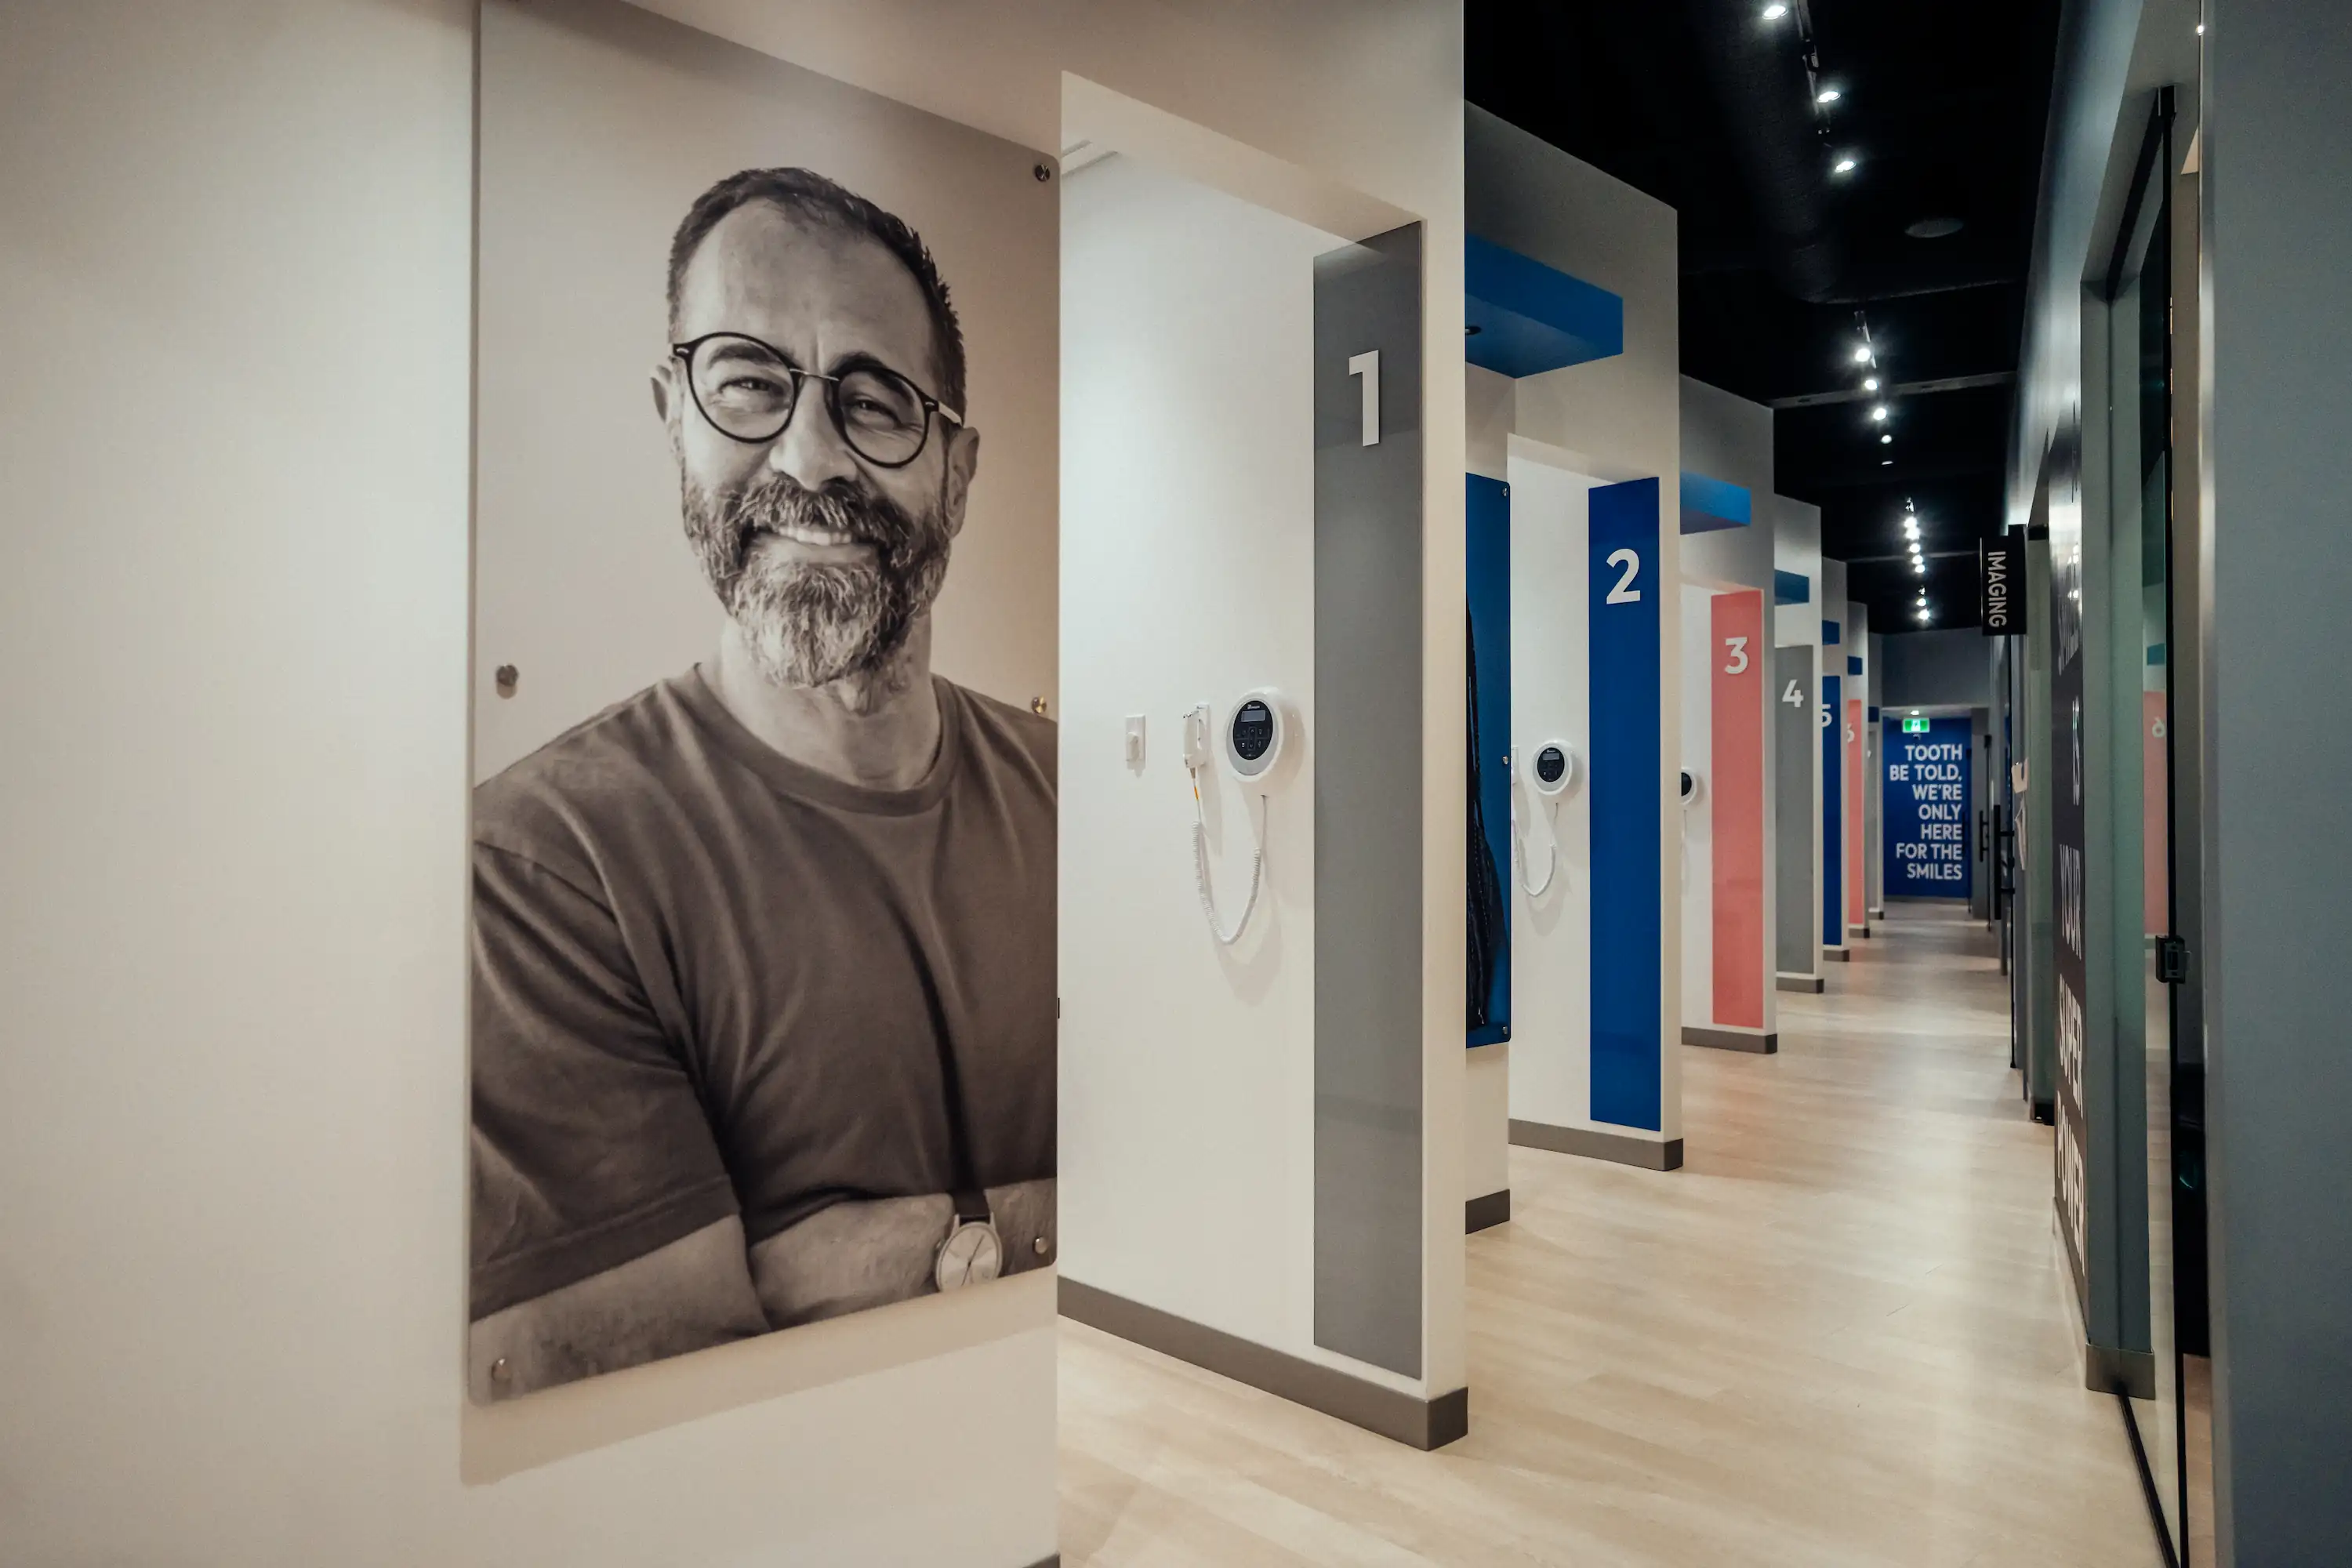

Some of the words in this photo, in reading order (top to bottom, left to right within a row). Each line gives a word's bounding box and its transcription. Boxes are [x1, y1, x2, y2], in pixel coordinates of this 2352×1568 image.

[1348, 350, 1380, 447] 1
[1606, 548, 1641, 604] 2
[1987, 551, 2007, 628] IMAGING
[1725, 637, 1749, 674] 3
[1782, 679, 1803, 708] 4
[1822, 704, 1832, 728] 5
[1904, 744, 1962, 761] TOOTH
[2072, 696, 2080, 805] IS
[1889, 764, 1909, 781] BE
[1918, 804, 1962, 820] ONLY
[1921, 824, 1962, 840] HERE
[1896, 843, 1927, 859] FOR
[1930, 844, 1962, 861] THE
[1907, 862, 1962, 880] SMILES
[2060, 844, 2082, 960] YOUR
[2060, 974, 2083, 1120] SUPER
[2057, 1090, 2085, 1276] POWER
